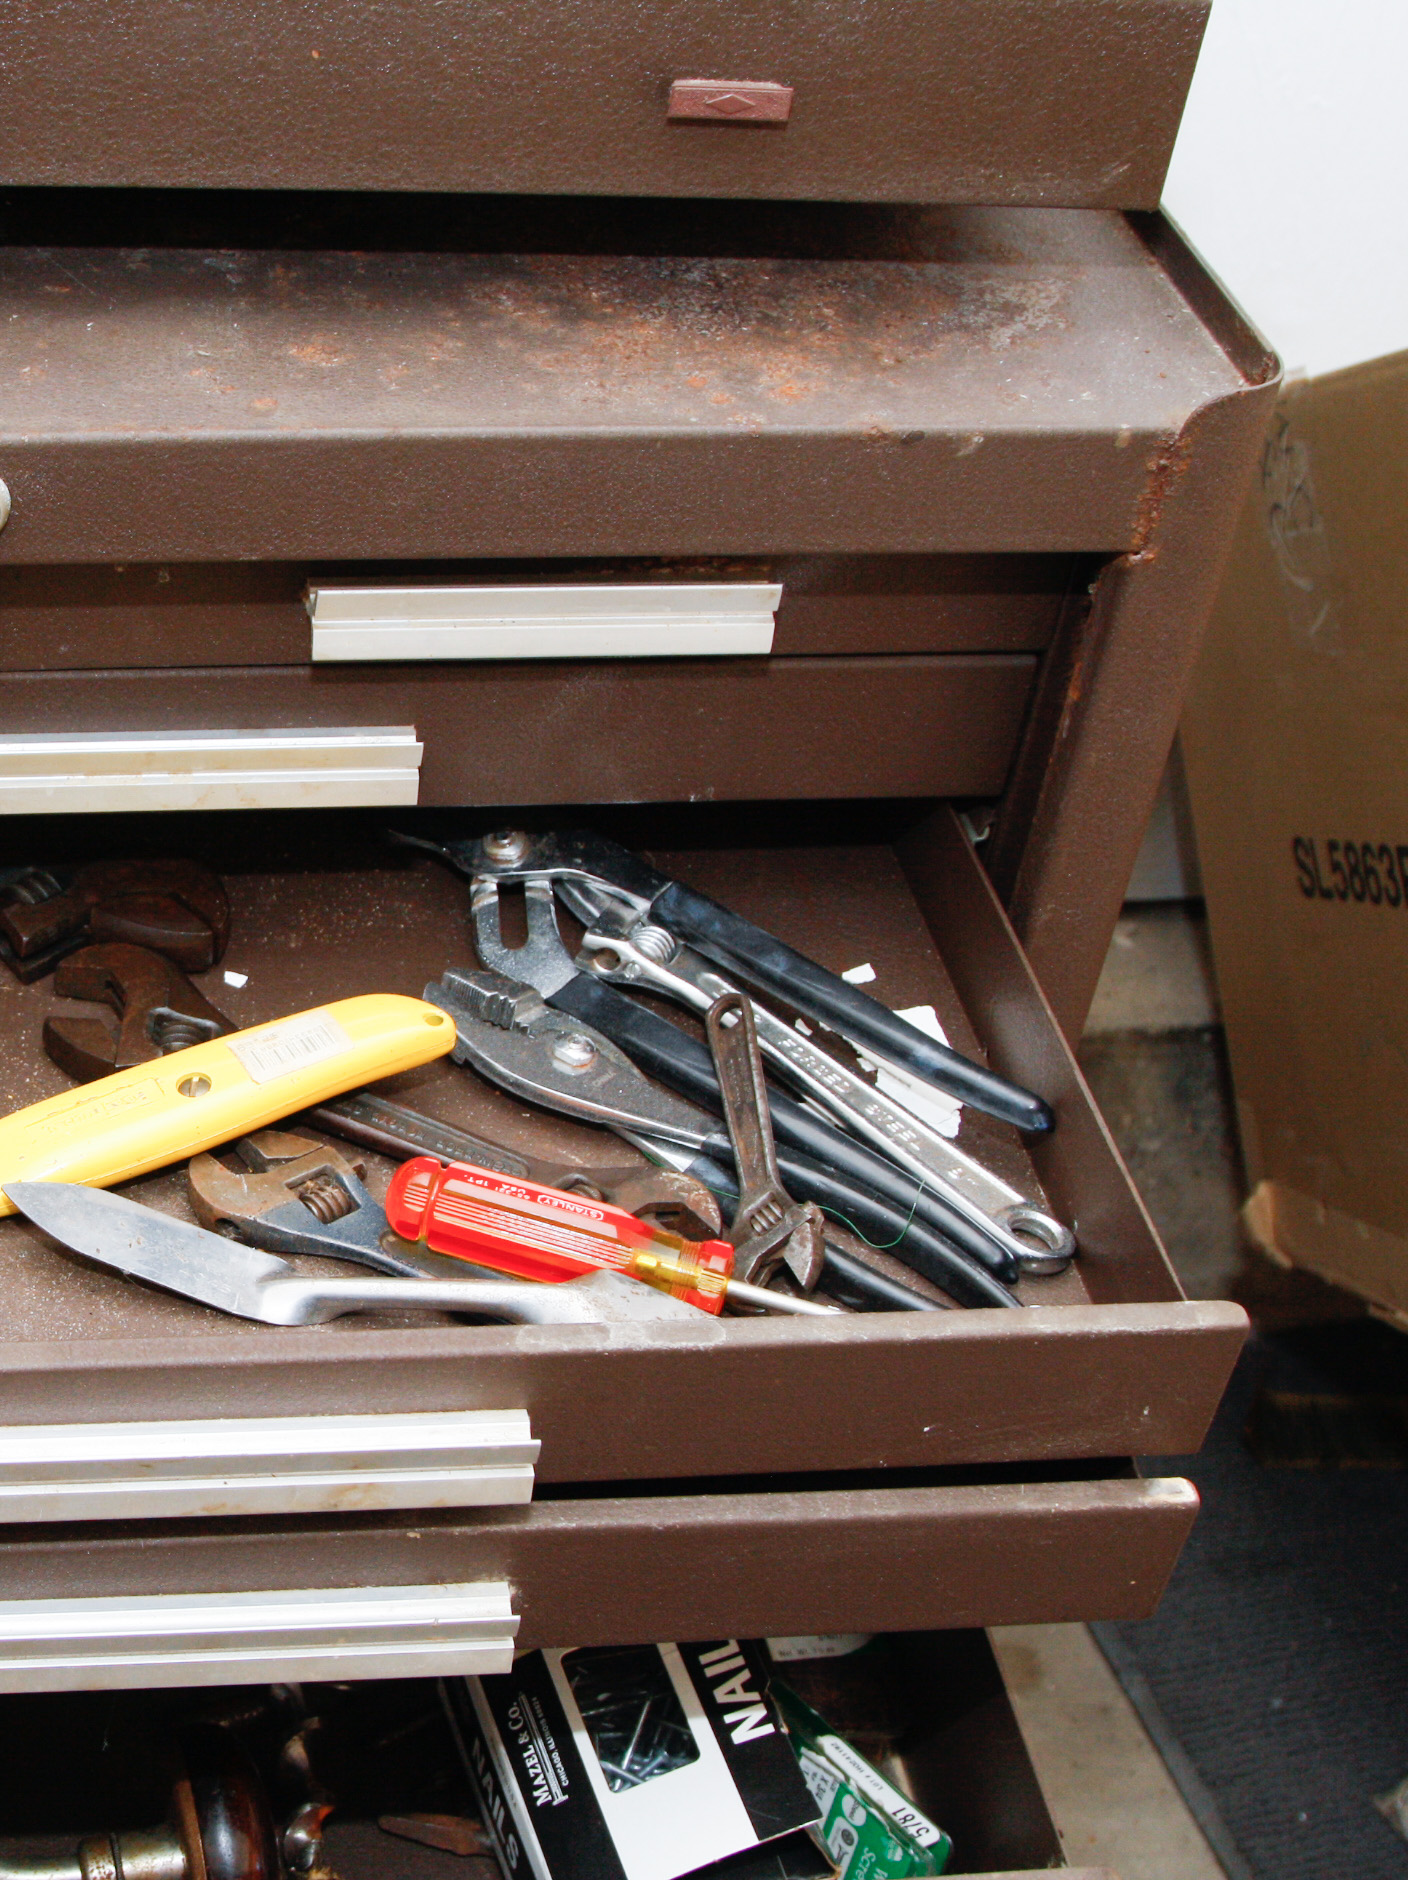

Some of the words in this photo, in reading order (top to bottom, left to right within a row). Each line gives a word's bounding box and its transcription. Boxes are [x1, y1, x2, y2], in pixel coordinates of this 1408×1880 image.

[502, 1183, 526, 1195] USA
[544, 1198, 598, 1218] STANLEY
[698, 1639, 775, 1744] NAIL
[507, 1702, 523, 1731] Co.
[518, 1732, 530, 1745] &
[522, 1744, 552, 1807] MAZEL
[551, 1748, 569, 1787] CHICAGO,
